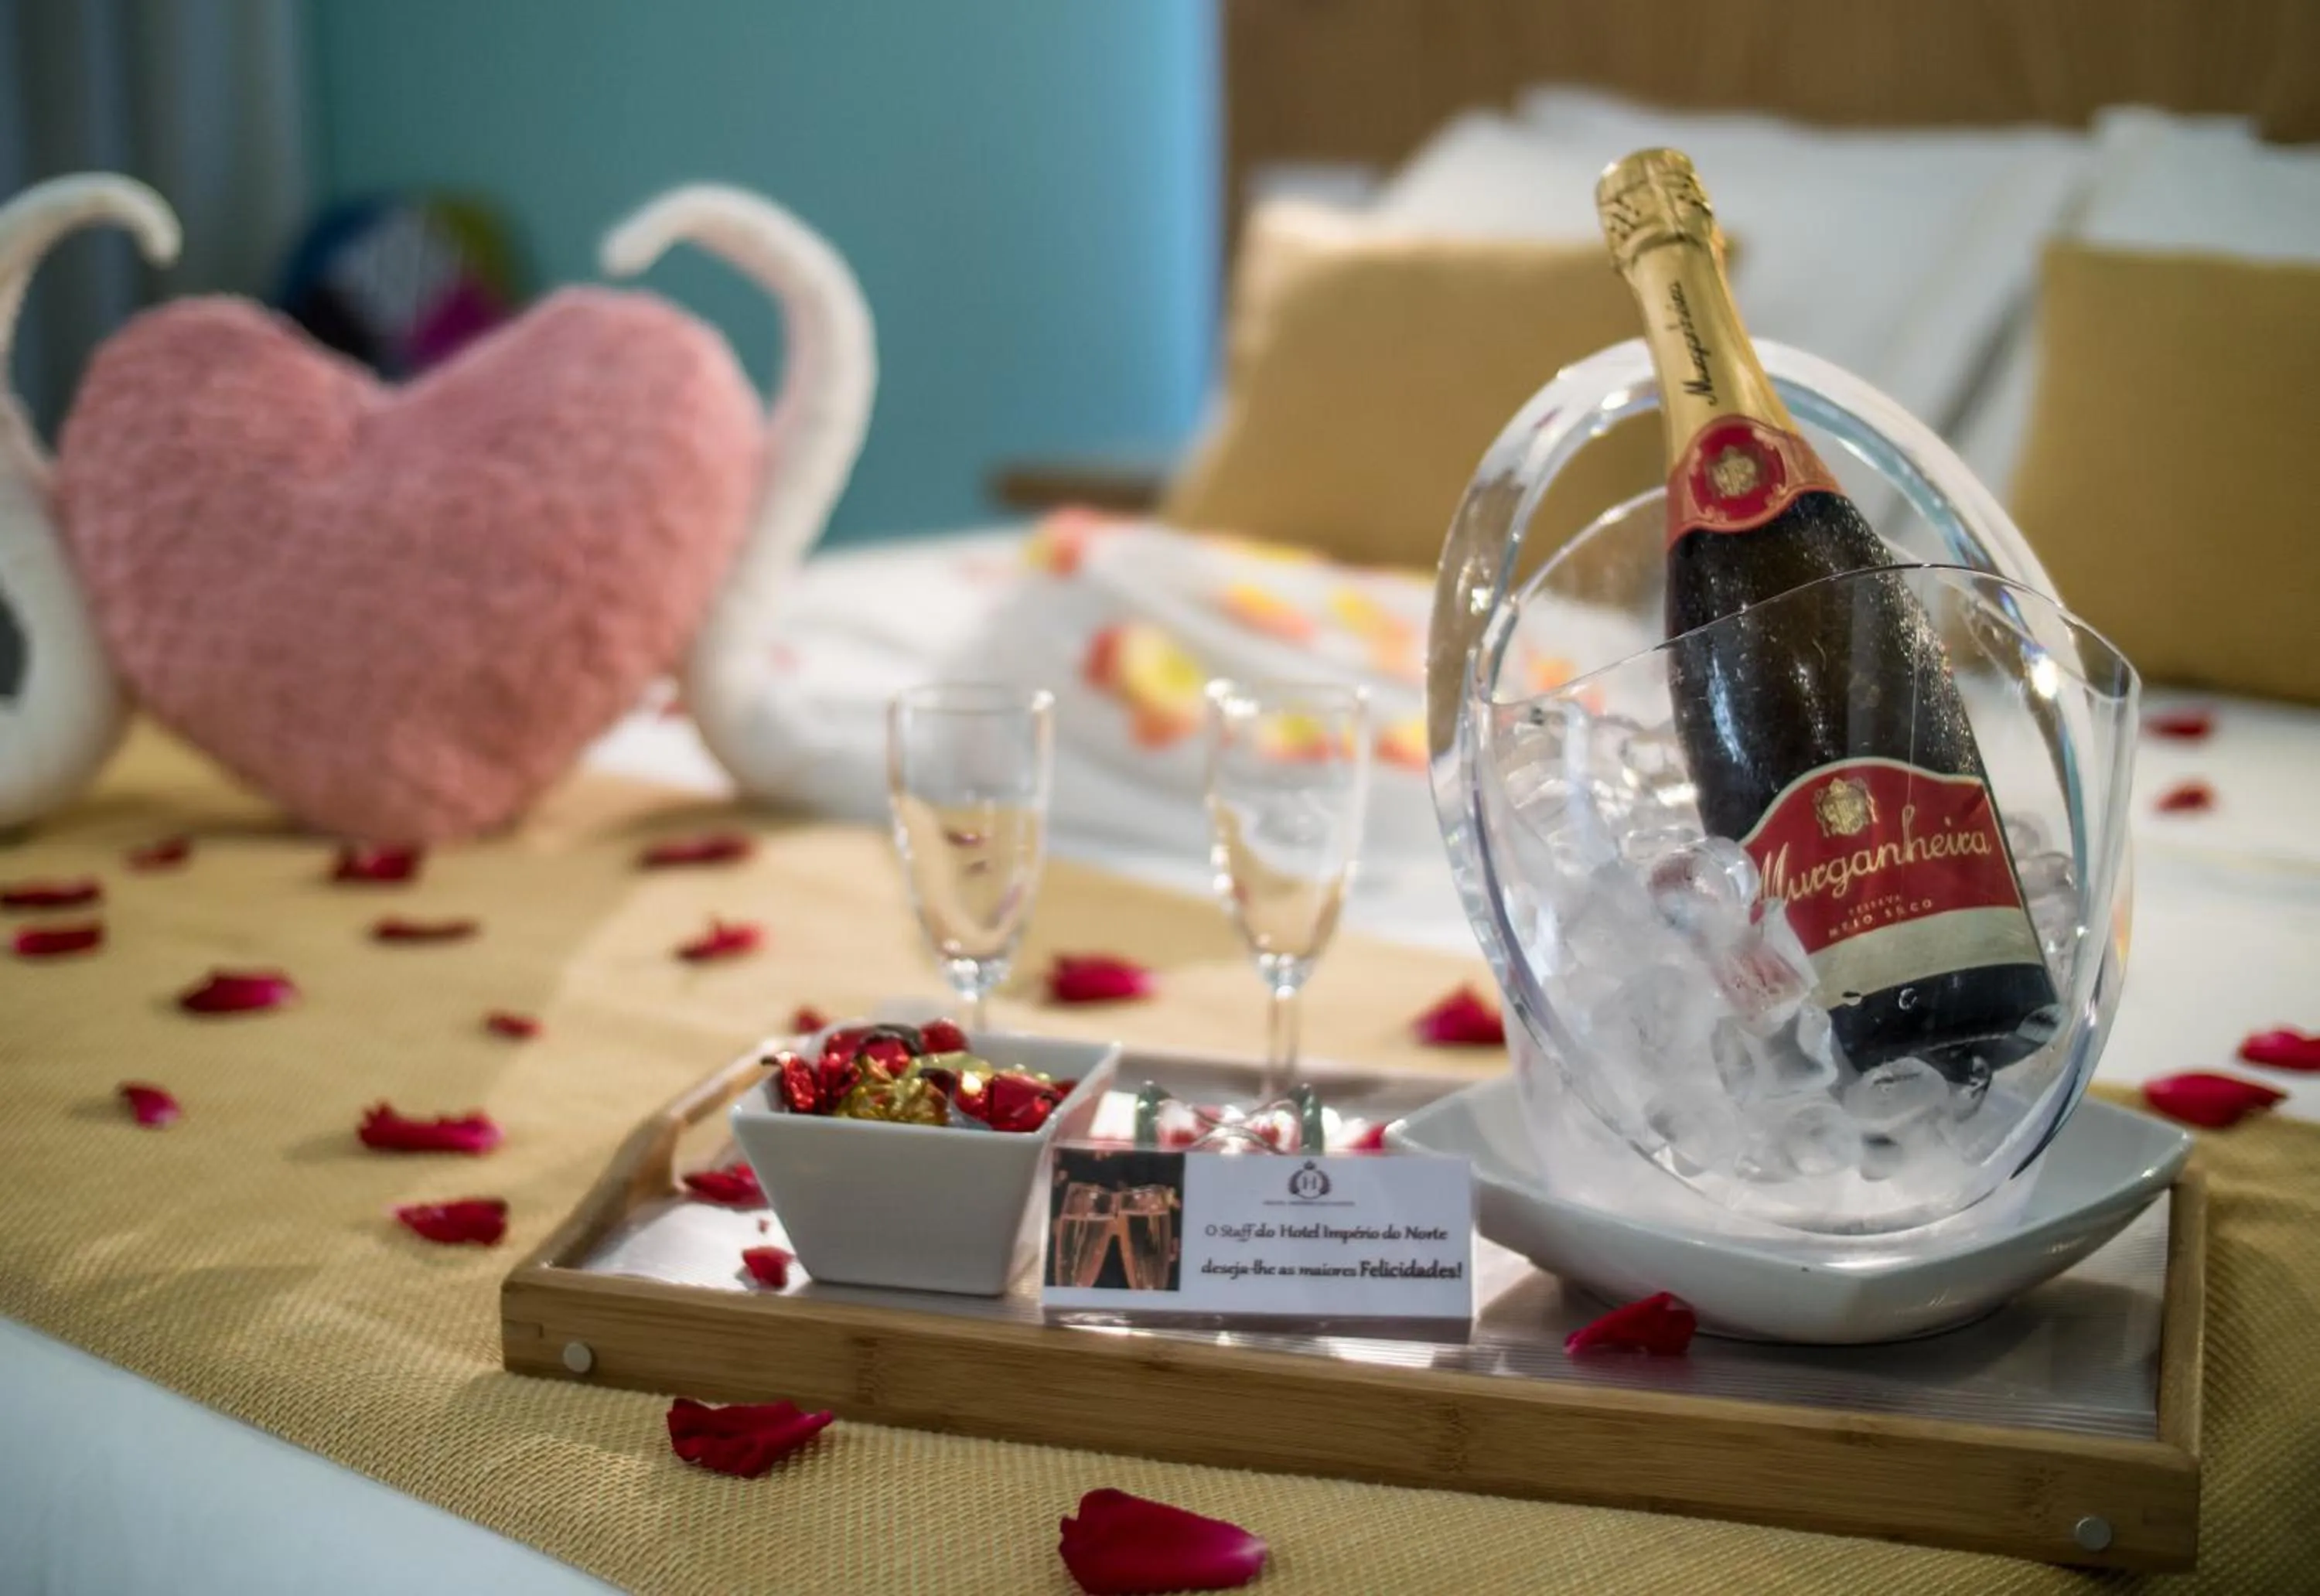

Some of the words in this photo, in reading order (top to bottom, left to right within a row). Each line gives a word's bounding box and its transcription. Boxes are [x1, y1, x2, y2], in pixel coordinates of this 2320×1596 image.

[1756, 804, 1992, 905] Murganheira
[1885, 899, 1932, 919] SECO
[1205, 1224, 1217, 1237] O
[1220, 1223, 1256, 1242] Staff
[1255, 1224, 1275, 1239] do
[1280, 1223, 1319, 1240] Hotel
[1323, 1223, 1380, 1244] Império
[1381, 1224, 1401, 1240] do
[1404, 1225, 1448, 1241] Norte
[1201, 1258, 1276, 1280] deseja-lhe
[1278, 1267, 1295, 1276] as
[1298, 1264, 1357, 1277] maiores
[1360, 1259, 1462, 1279] Felicidades!
